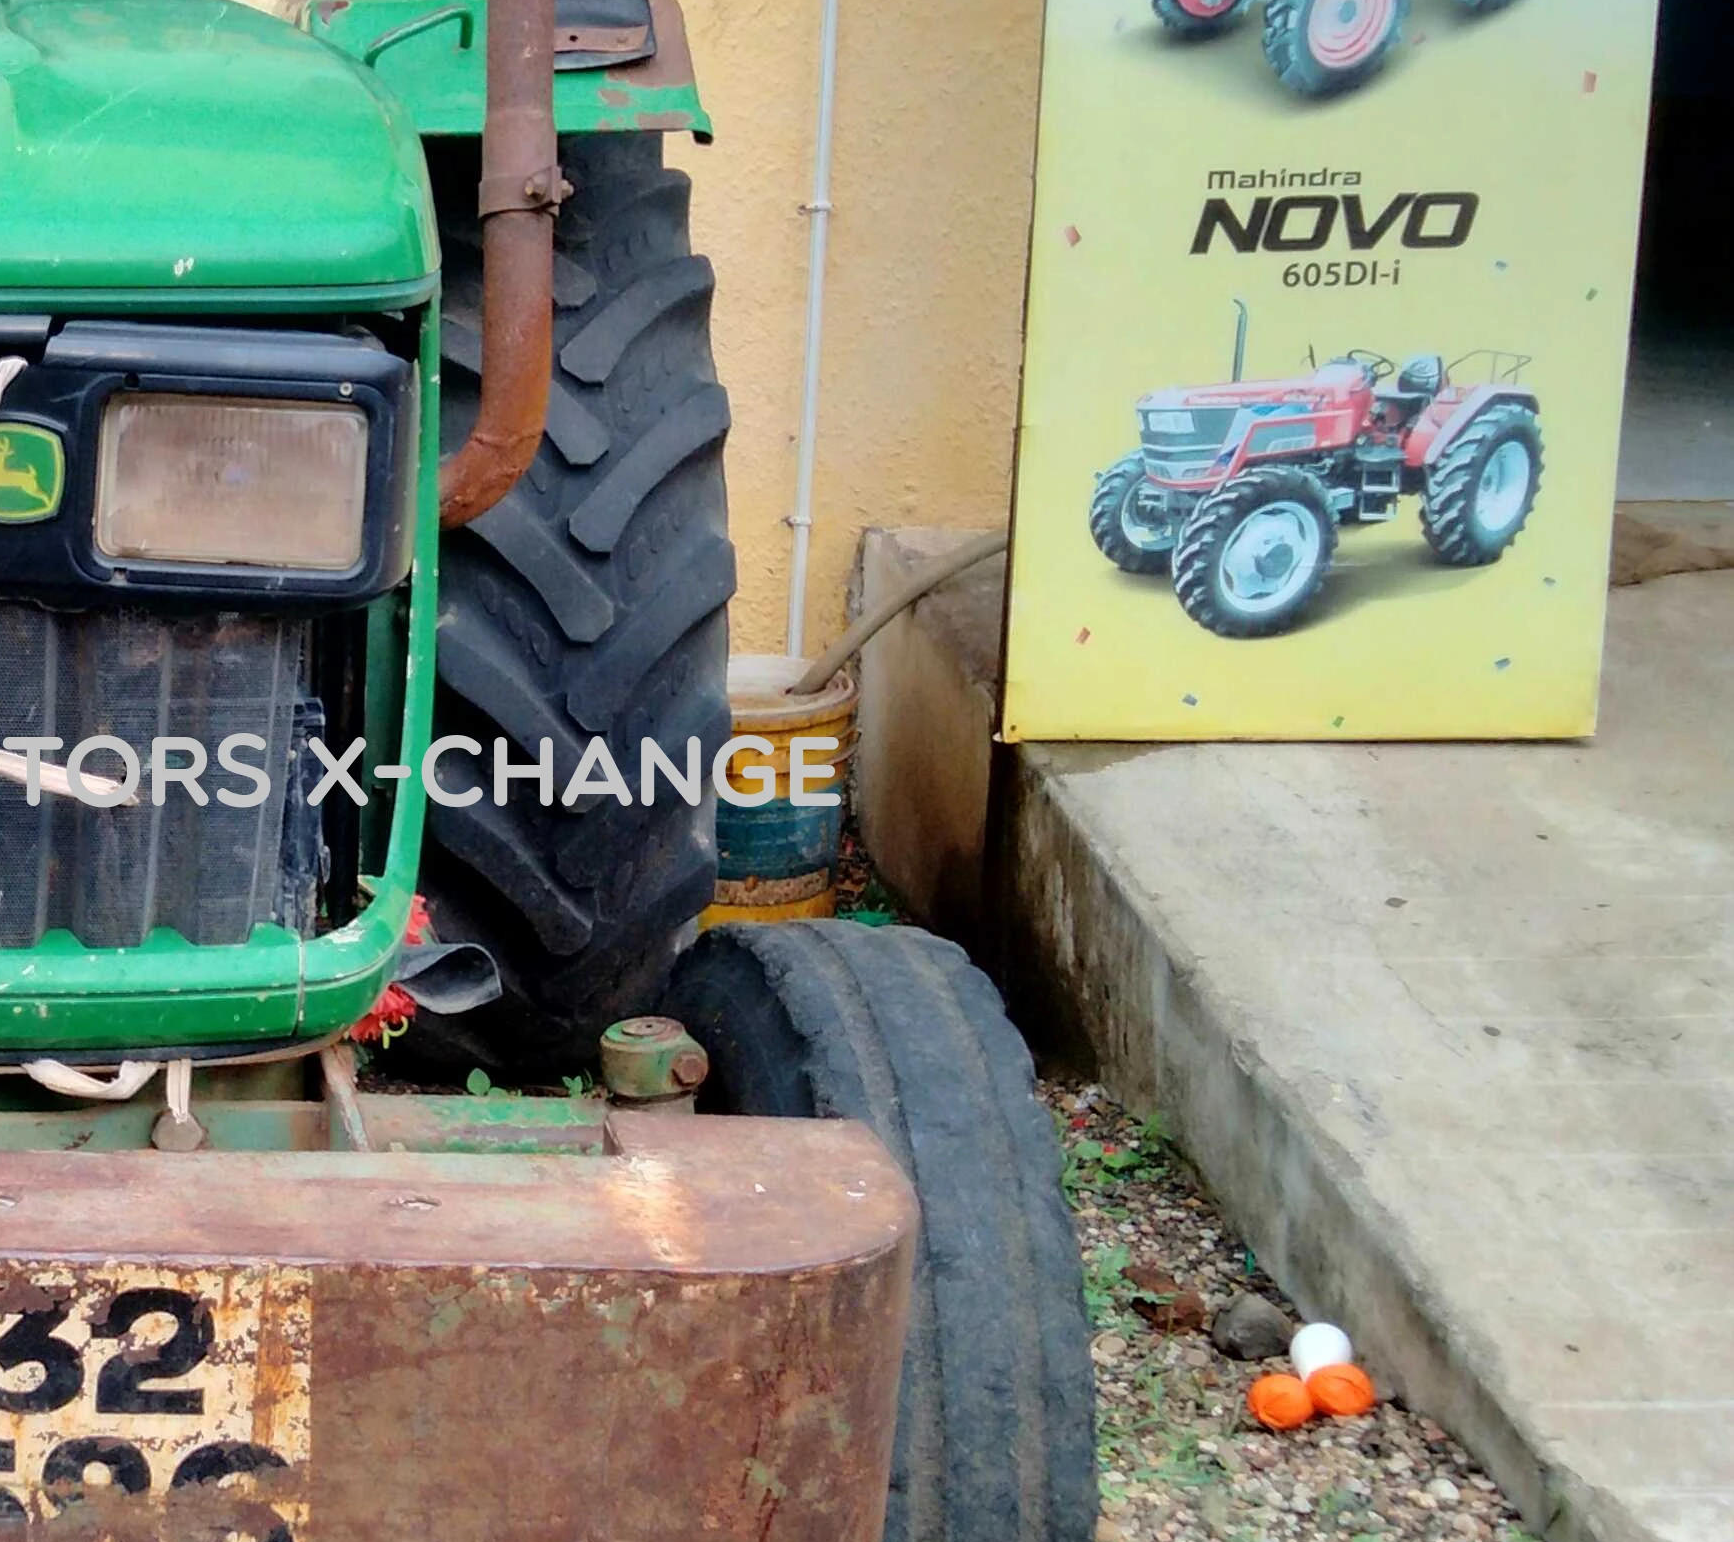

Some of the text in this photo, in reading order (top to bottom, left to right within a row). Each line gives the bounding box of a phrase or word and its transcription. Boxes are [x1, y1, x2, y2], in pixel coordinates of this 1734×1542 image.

[1206, 167, 1363, 190] Mahindra
[1189, 191, 1480, 255] NOVO
[1281, 260, 1401, 288] 605DI-i
